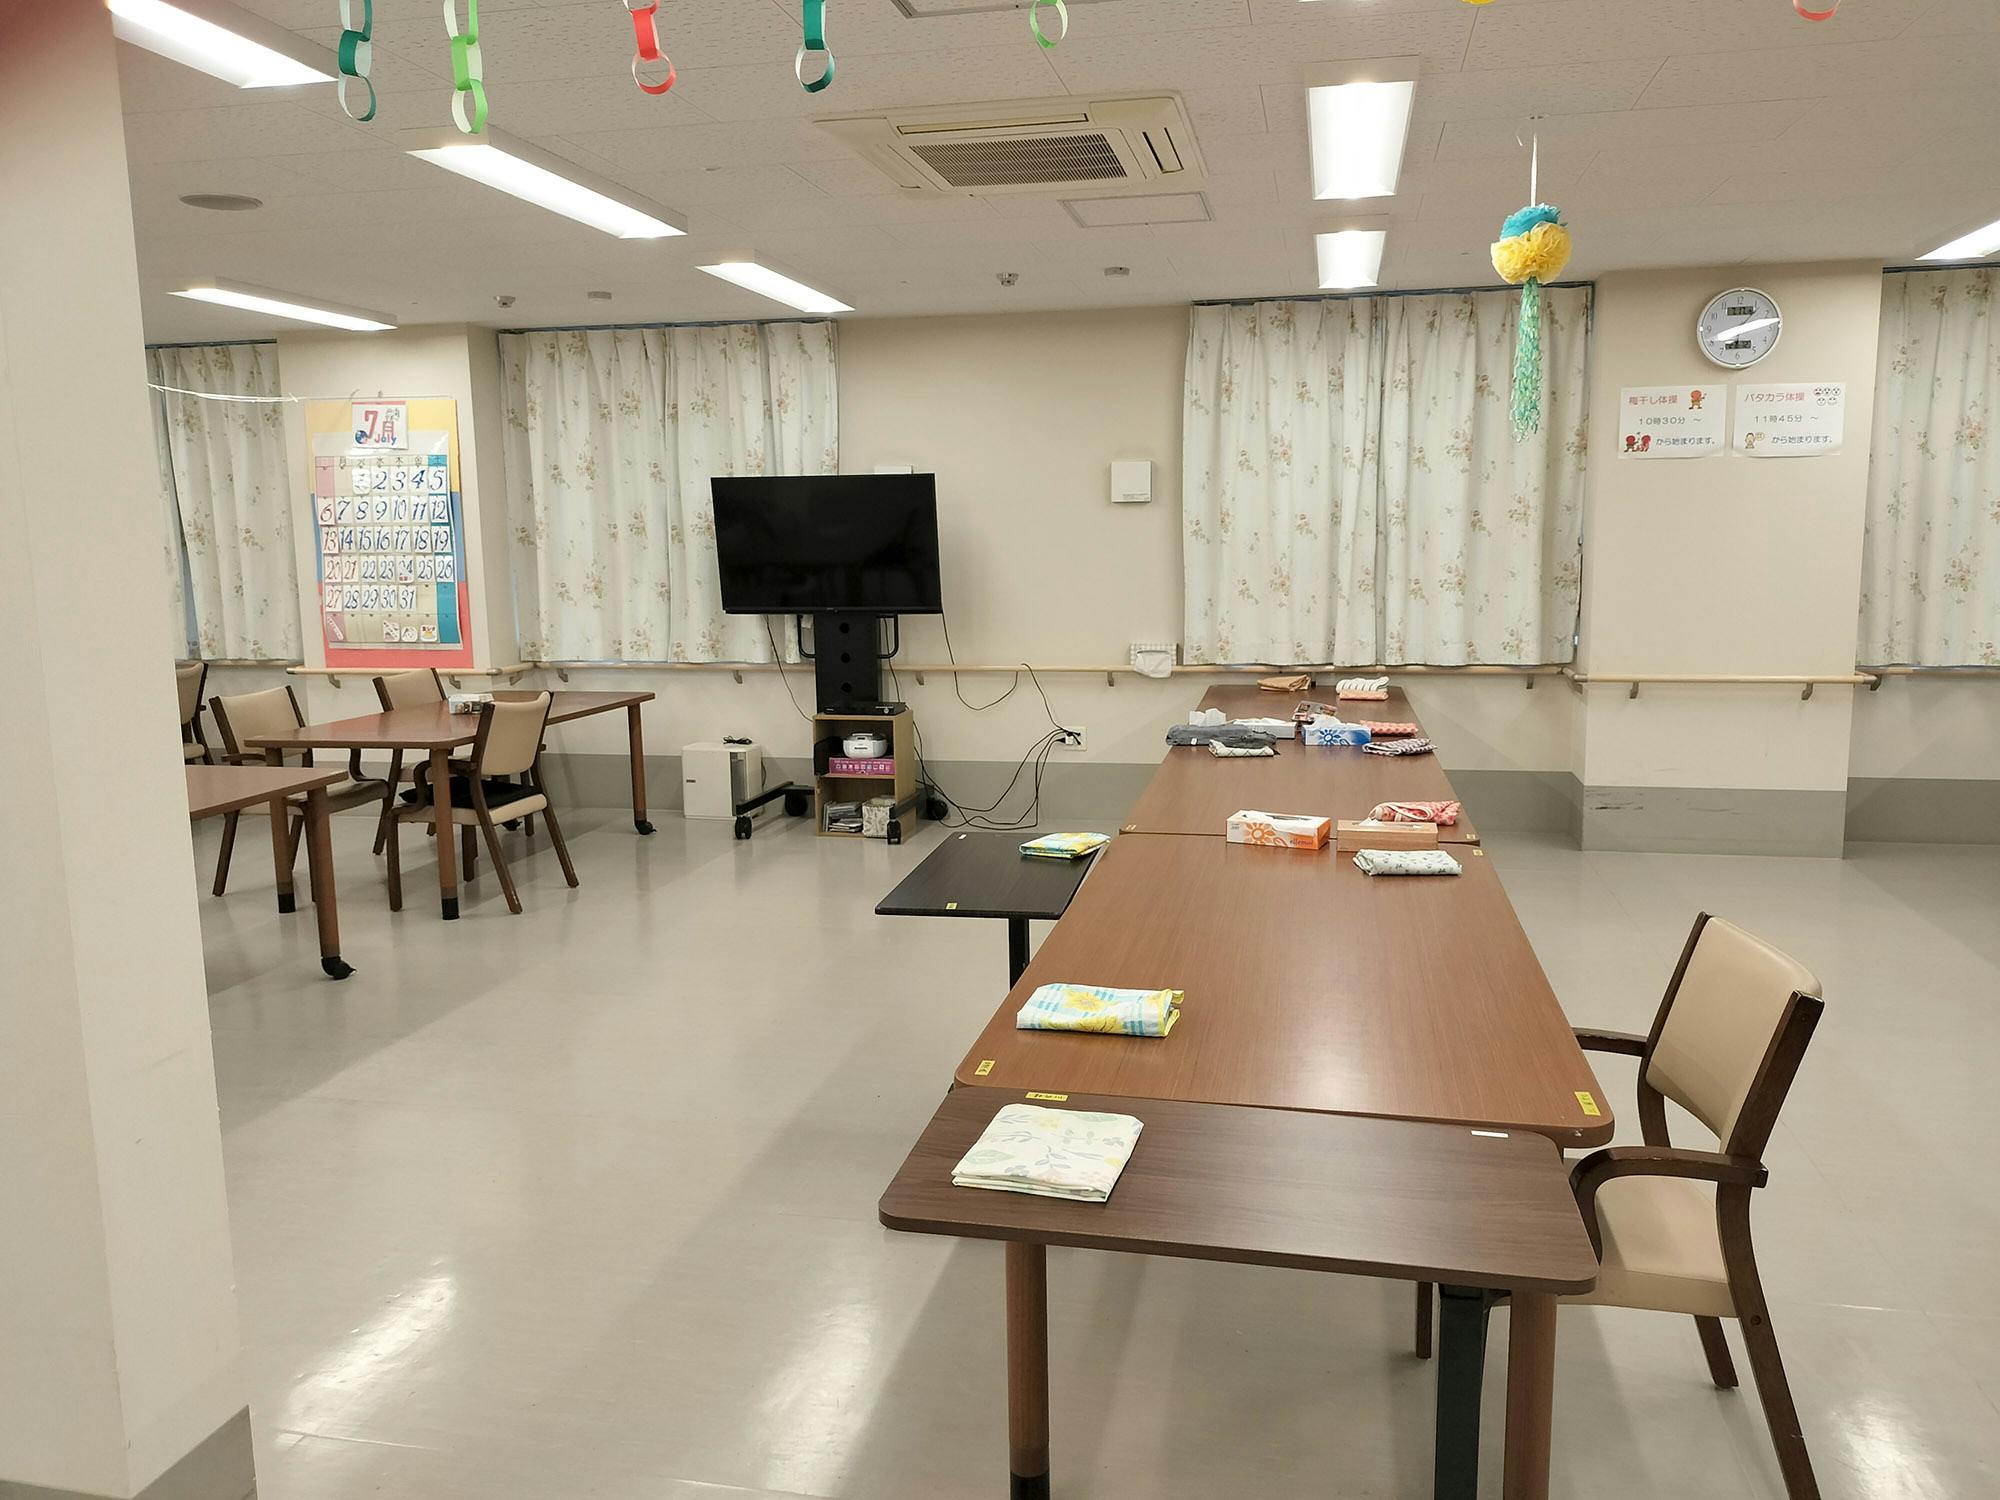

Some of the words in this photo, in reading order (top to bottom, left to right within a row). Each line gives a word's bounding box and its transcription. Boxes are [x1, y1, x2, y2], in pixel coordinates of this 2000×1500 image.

[373, 471, 387, 490] 2
[392, 471, 406, 491] 3
[411, 469, 426, 489] 4
[430, 469, 445, 491] 5
[320, 504, 333, 522] 6
[337, 500, 351, 520] 7
[356, 501, 369, 520] 8
[375, 501, 388, 520] 9
[393, 499, 407, 520] 10
[412, 502, 427, 520] 11
[431, 500, 446, 520] 12
[323, 530, 338, 551] 13
[340, 529, 353, 550] 14
[359, 529, 372, 550] 15
[376, 529, 391, 550] 16
[395, 530, 410, 550] 17
[414, 529, 429, 550] 18
[434, 530, 449, 551] 19
[344, 560, 357, 580] 21
[362, 560, 376, 579] 22
[380, 560, 394, 580] 23
[417, 560, 433, 580] 25
[436, 560, 453, 579] 26
[326, 589, 341, 608] 27
[344, 590, 359, 609] 28
[362, 589, 379, 609] 29
[381, 589, 396, 608] 30
[399, 589, 415, 609] 31
